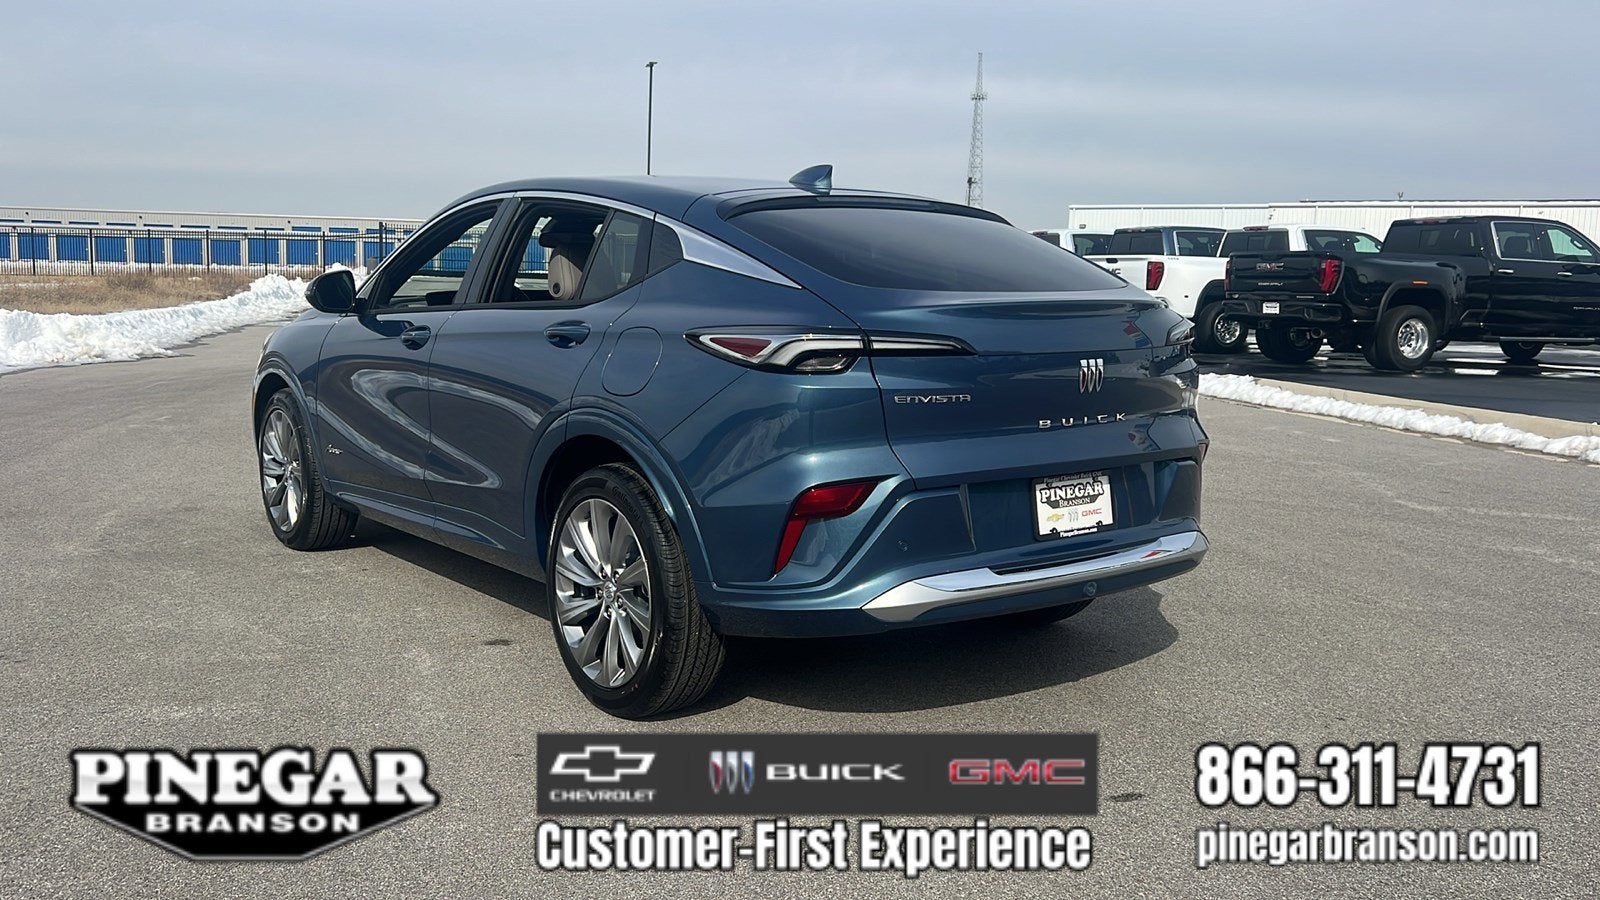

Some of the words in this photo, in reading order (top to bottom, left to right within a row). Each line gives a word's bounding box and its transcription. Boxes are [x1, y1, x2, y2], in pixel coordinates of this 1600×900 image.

[894, 394, 971, 404] ENVISTA
[1039, 412, 1126, 428] BUICK
[1041, 482, 1104, 502] PINEGAR
[1082, 508, 1102, 516] GMC
